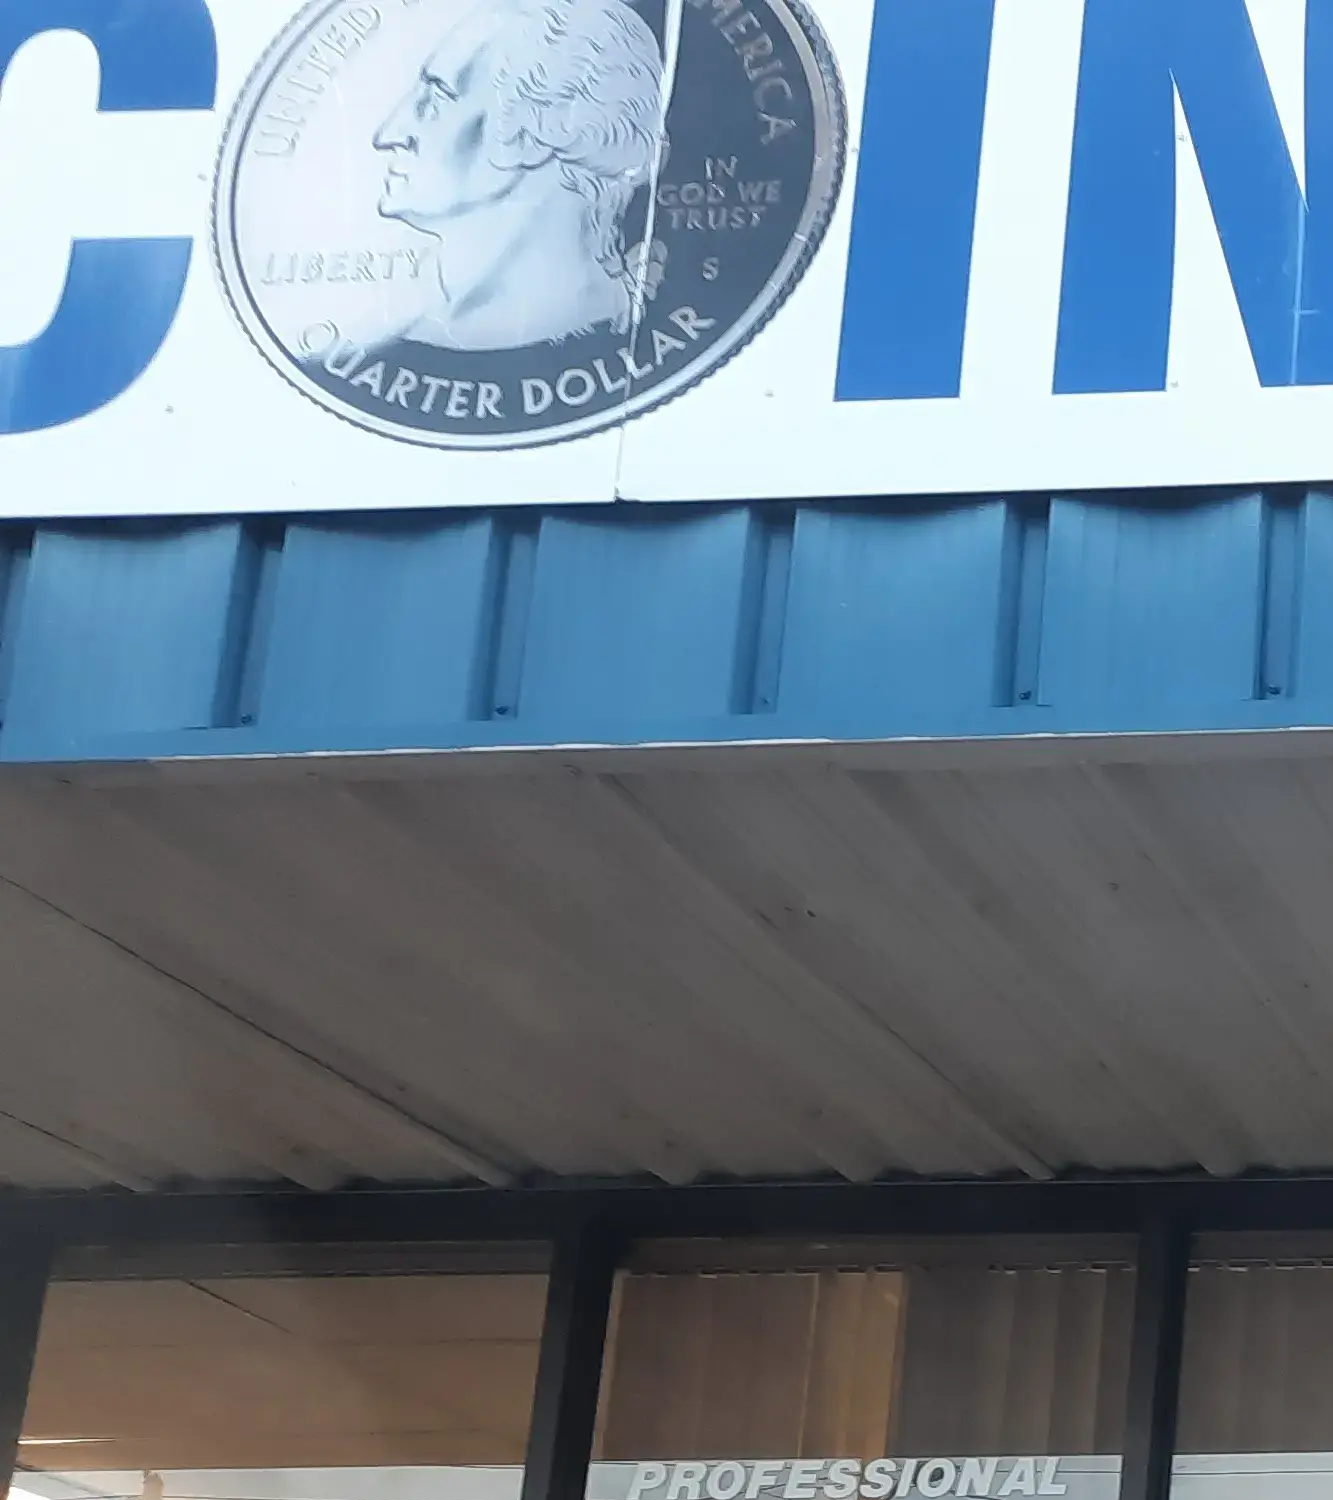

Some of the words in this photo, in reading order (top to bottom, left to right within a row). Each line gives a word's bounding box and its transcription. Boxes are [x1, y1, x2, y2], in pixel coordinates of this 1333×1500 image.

[705, 155, 737, 180] IN
[658, 181, 724, 206] GOD
[737, 180, 781, 202] WE
[668, 205, 767, 231] TRUST
[261, 246, 430, 286] LIBERTY
[702, 256, 720, 282] S
[298, 319, 506, 419] QUARTER
[521, 304, 717, 416] DOLLAR
